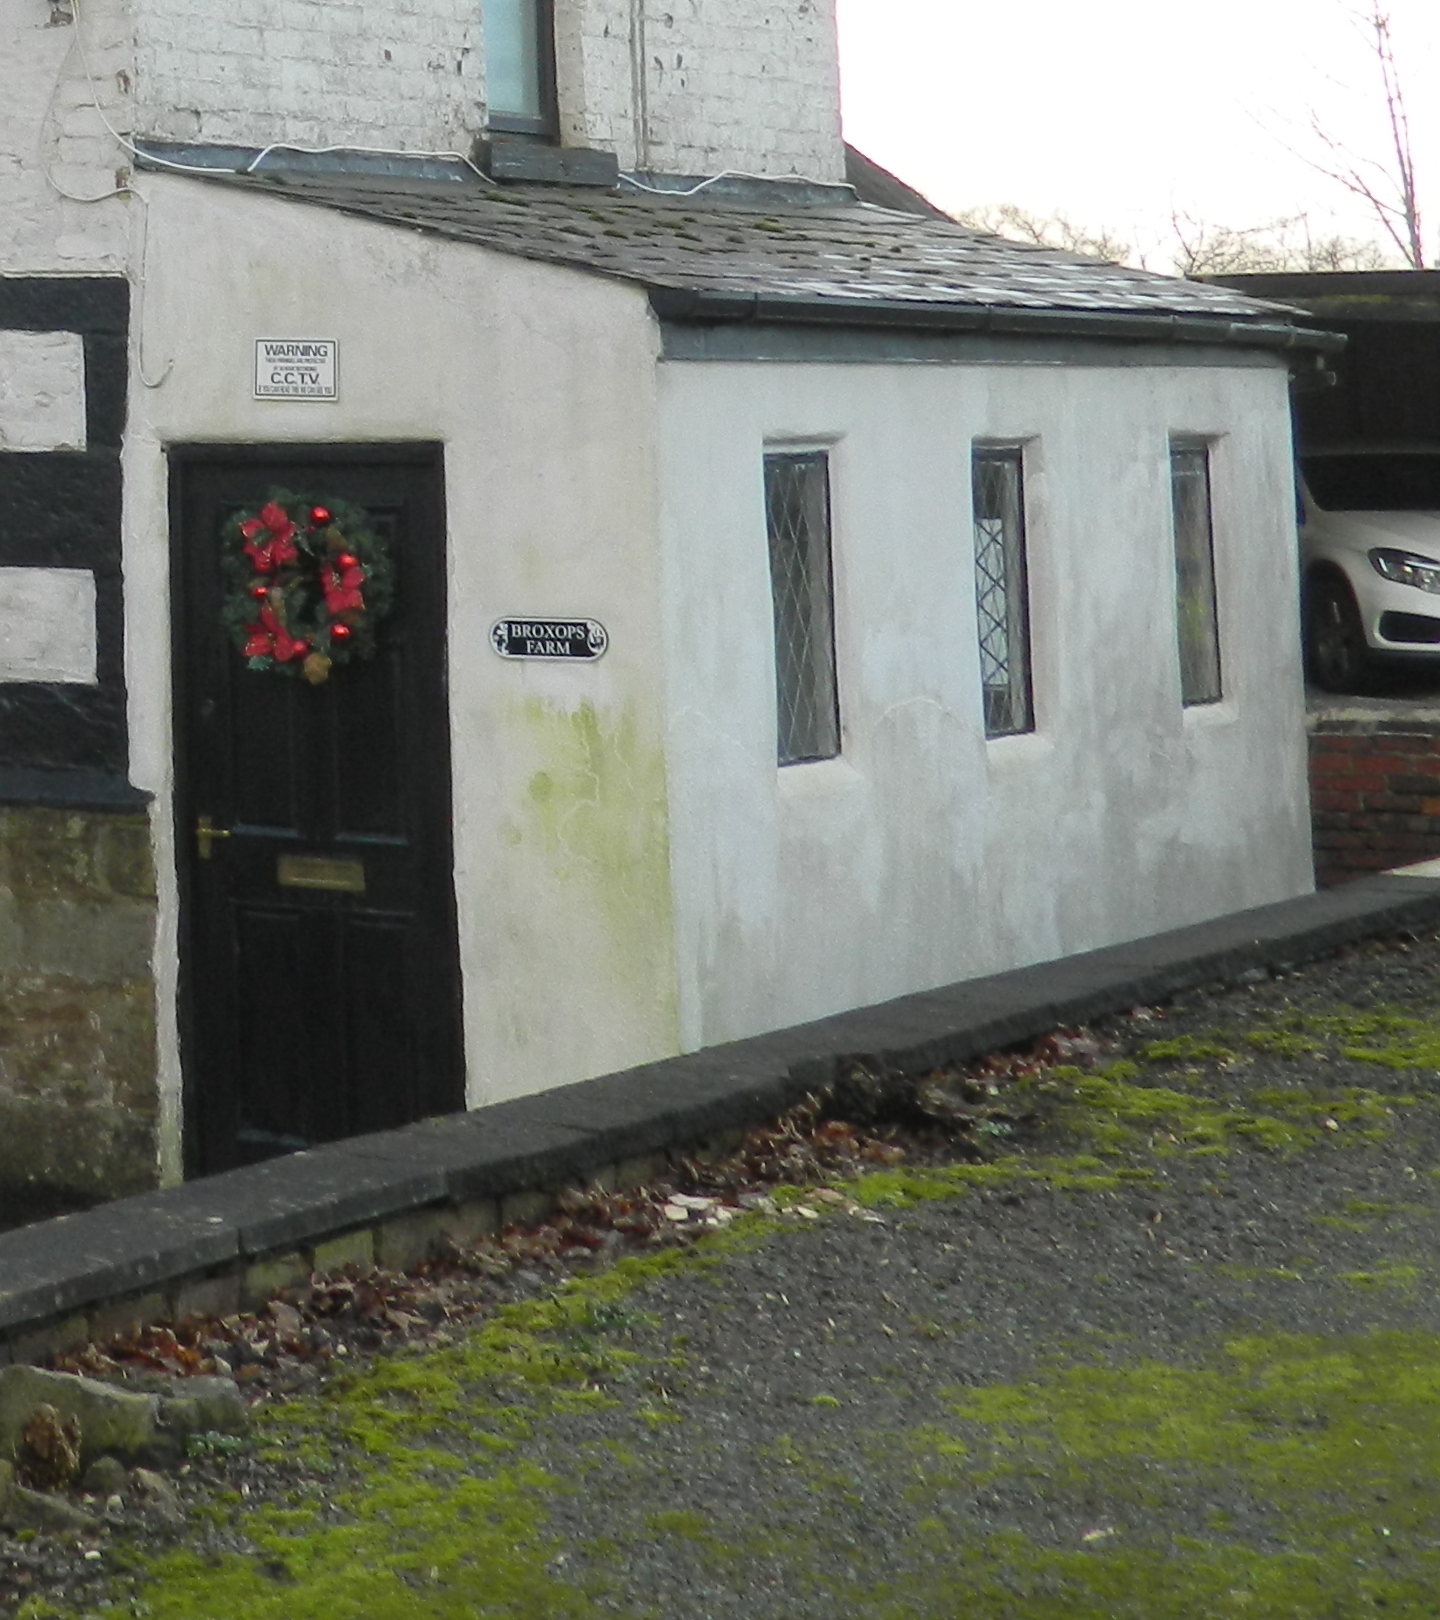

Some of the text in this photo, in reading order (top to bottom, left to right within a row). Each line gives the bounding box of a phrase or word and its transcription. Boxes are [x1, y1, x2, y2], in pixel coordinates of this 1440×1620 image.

[264, 344, 328, 357] WARNING
[511, 623, 585, 640] BROXOPS
[526, 640, 571, 655] FARM
